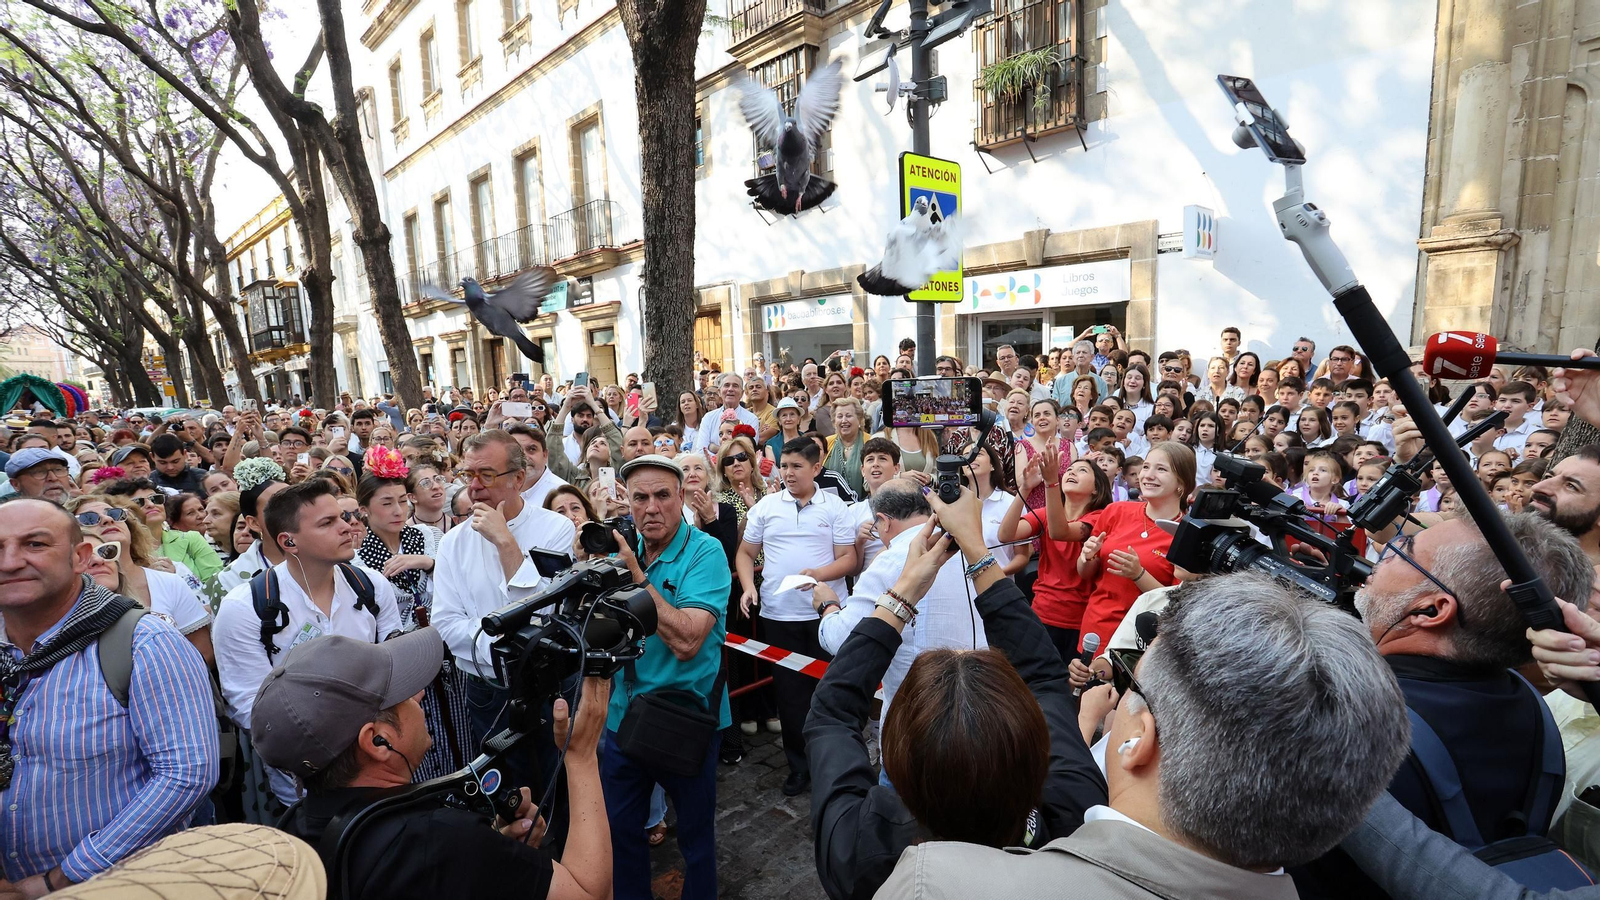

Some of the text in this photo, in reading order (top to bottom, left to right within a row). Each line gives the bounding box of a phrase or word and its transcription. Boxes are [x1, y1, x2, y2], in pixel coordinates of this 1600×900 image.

[909, 164, 957, 183] ATENCIÓN
[1063, 272, 1095, 284] Libros
[918, 280, 959, 292] EATONES
[1061, 284, 1099, 297] Juegos
[1432, 356, 1468, 376] 7
[1469, 355, 1483, 378] siete
[1309, 583, 1332, 596] SONY
